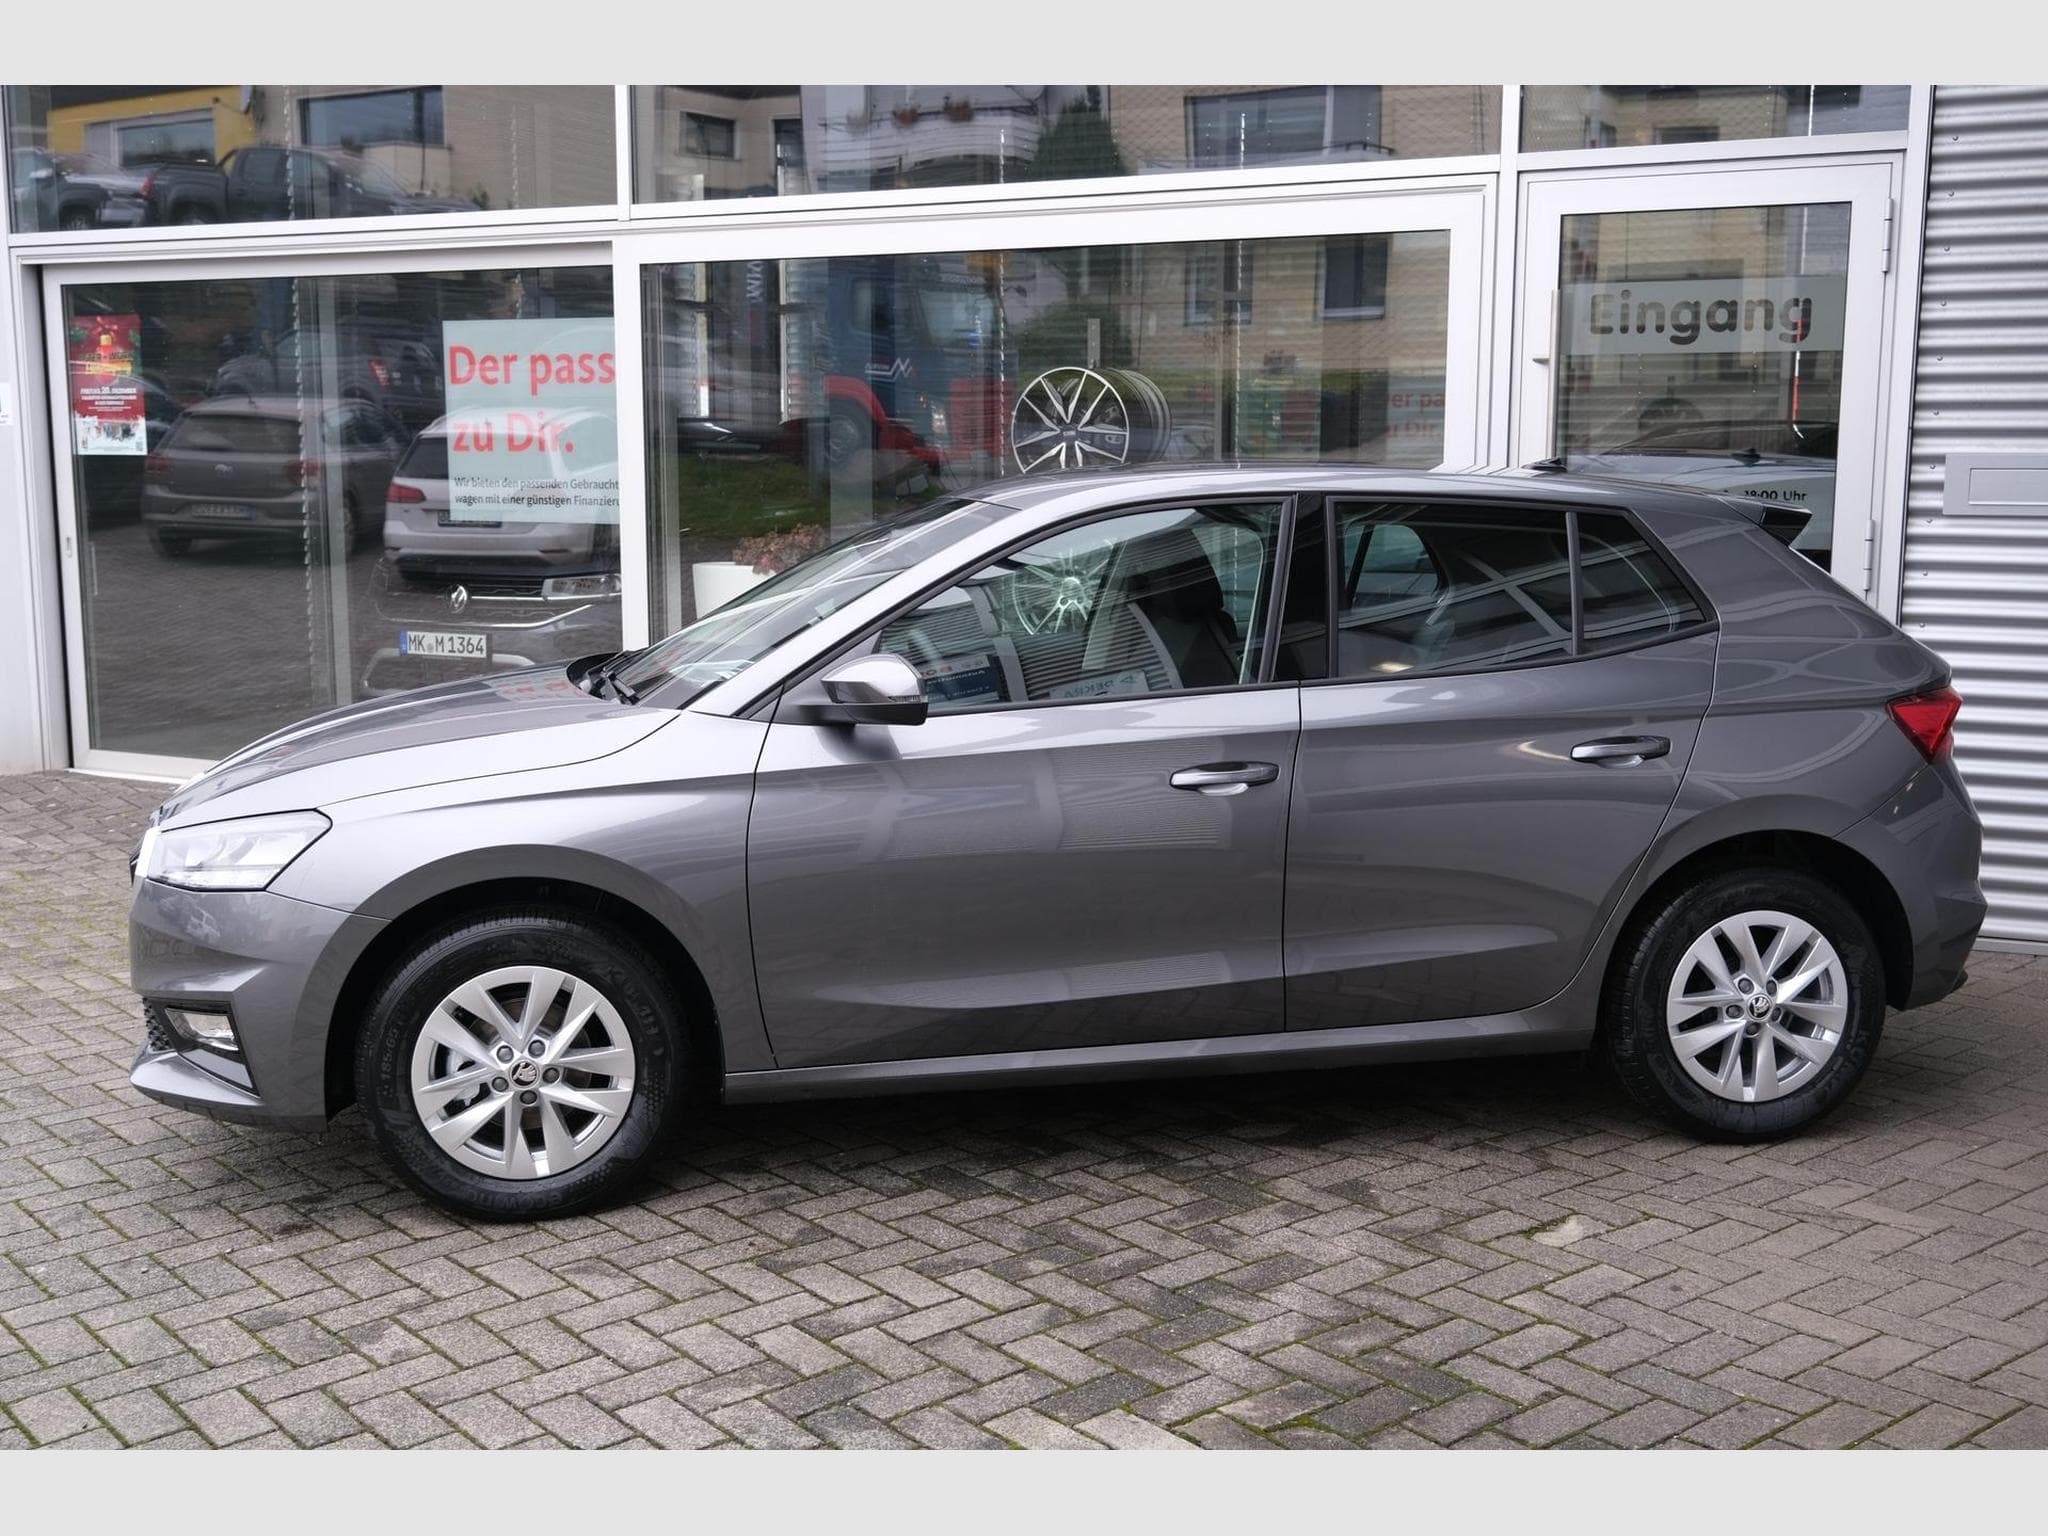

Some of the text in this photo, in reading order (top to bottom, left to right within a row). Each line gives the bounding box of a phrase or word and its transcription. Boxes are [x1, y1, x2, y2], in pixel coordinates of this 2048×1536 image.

[1591, 289, 1812, 345] Eingang
[449, 346, 616, 396] Der pass
[453, 411, 574, 453] zu Dir.
[454, 477, 619, 491] Wir bieten den passenden Gebraucht
[455, 496, 483, 507] wagen
[485, 495, 501, 504] mit
[501, 495, 524, 505] einer
[527, 495, 571, 508] günstigen
[1783, 490, 1807, 501] Uhr
[408, 634, 426, 652] MK
